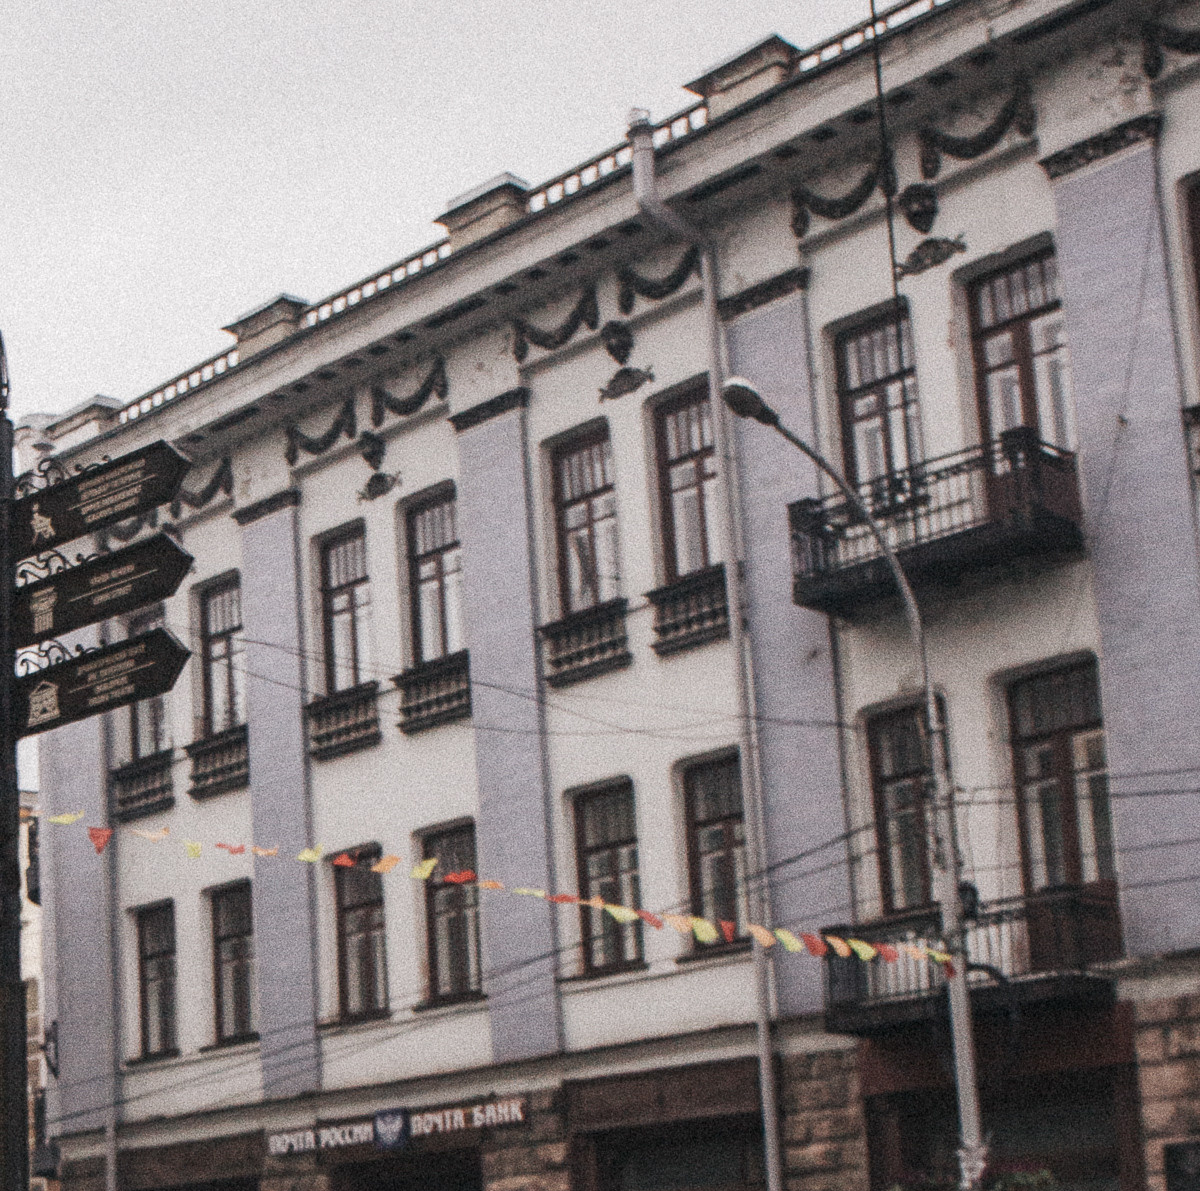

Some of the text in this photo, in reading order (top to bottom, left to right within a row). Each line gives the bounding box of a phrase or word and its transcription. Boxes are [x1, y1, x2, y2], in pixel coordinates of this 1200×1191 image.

[409, 1099, 524, 1136] ПОЧТА БАНК
[268, 1123, 374, 1154] ПОЧТА РОССИИ
